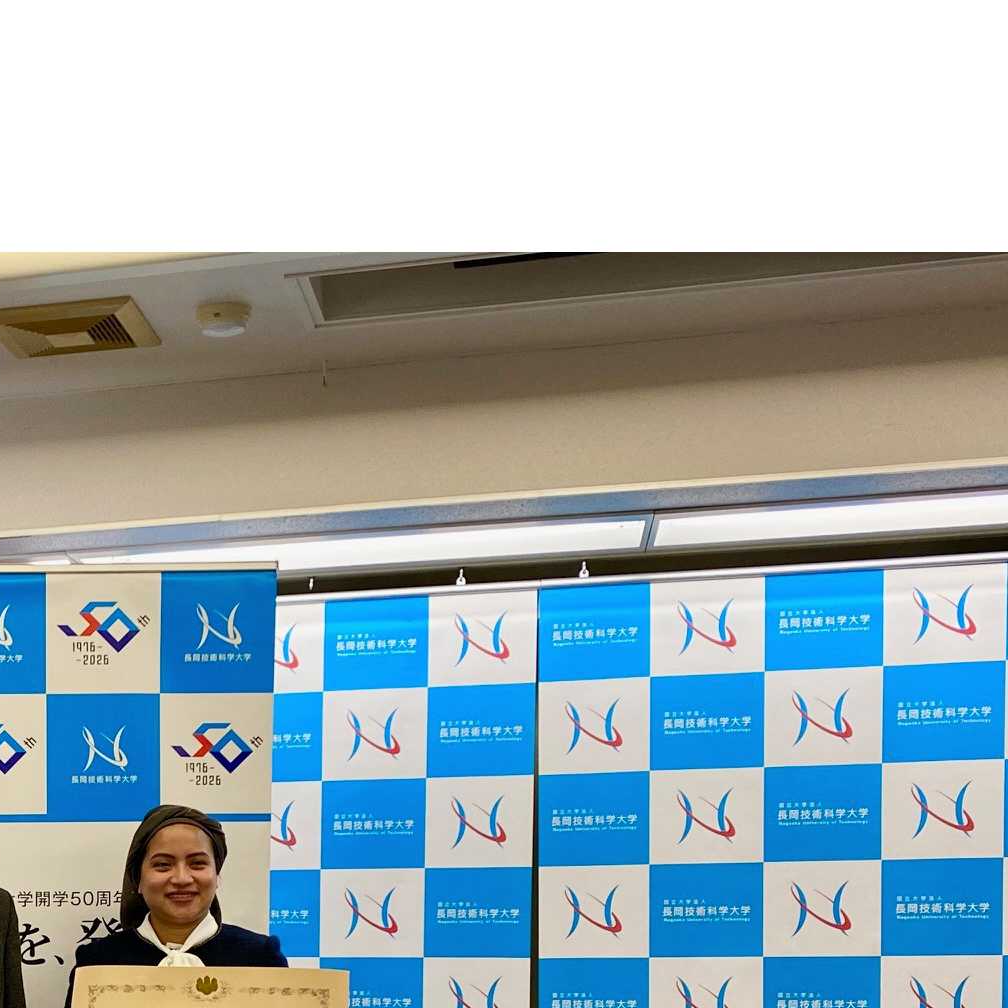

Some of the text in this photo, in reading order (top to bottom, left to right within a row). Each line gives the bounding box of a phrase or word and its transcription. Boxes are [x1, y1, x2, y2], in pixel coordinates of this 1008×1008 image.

[778, 615, 871, 628] 長岡技術科学大学
[552, 627, 638, 641] 長岡技術科学大学
[336, 639, 417, 651] 長岡技術科学大学
[76, 654, 110, 665] -2026
[184, 653, 251, 662] 長岡技術科学大学
[897, 706, 992, 720] 長岡技術科学大学
[663, 716, 751, 729] 長岡技術科学大学
[440, 727, 523, 738] 長岡技術科学大学
[71, 775, 138, 784] 長岡技術科学大学
[189, 775, 222, 786] -2026
[778, 808, 869, 820] 長岡技術科学大学
[333, 821, 414, 831] 長岡技術科学大学
[552, 815, 638, 826] 長岡技術科学大学
[662, 906, 751, 917] 長岡技術科学大学
[896, 903, 990, 913] 長岡技術科学大学
[436, 909, 519, 919] 長岡技術科学大学
[552, 999, 638, 1008] 長岡技術科学大学
[777, 999, 867, 1008] 長岡技術科学大学
